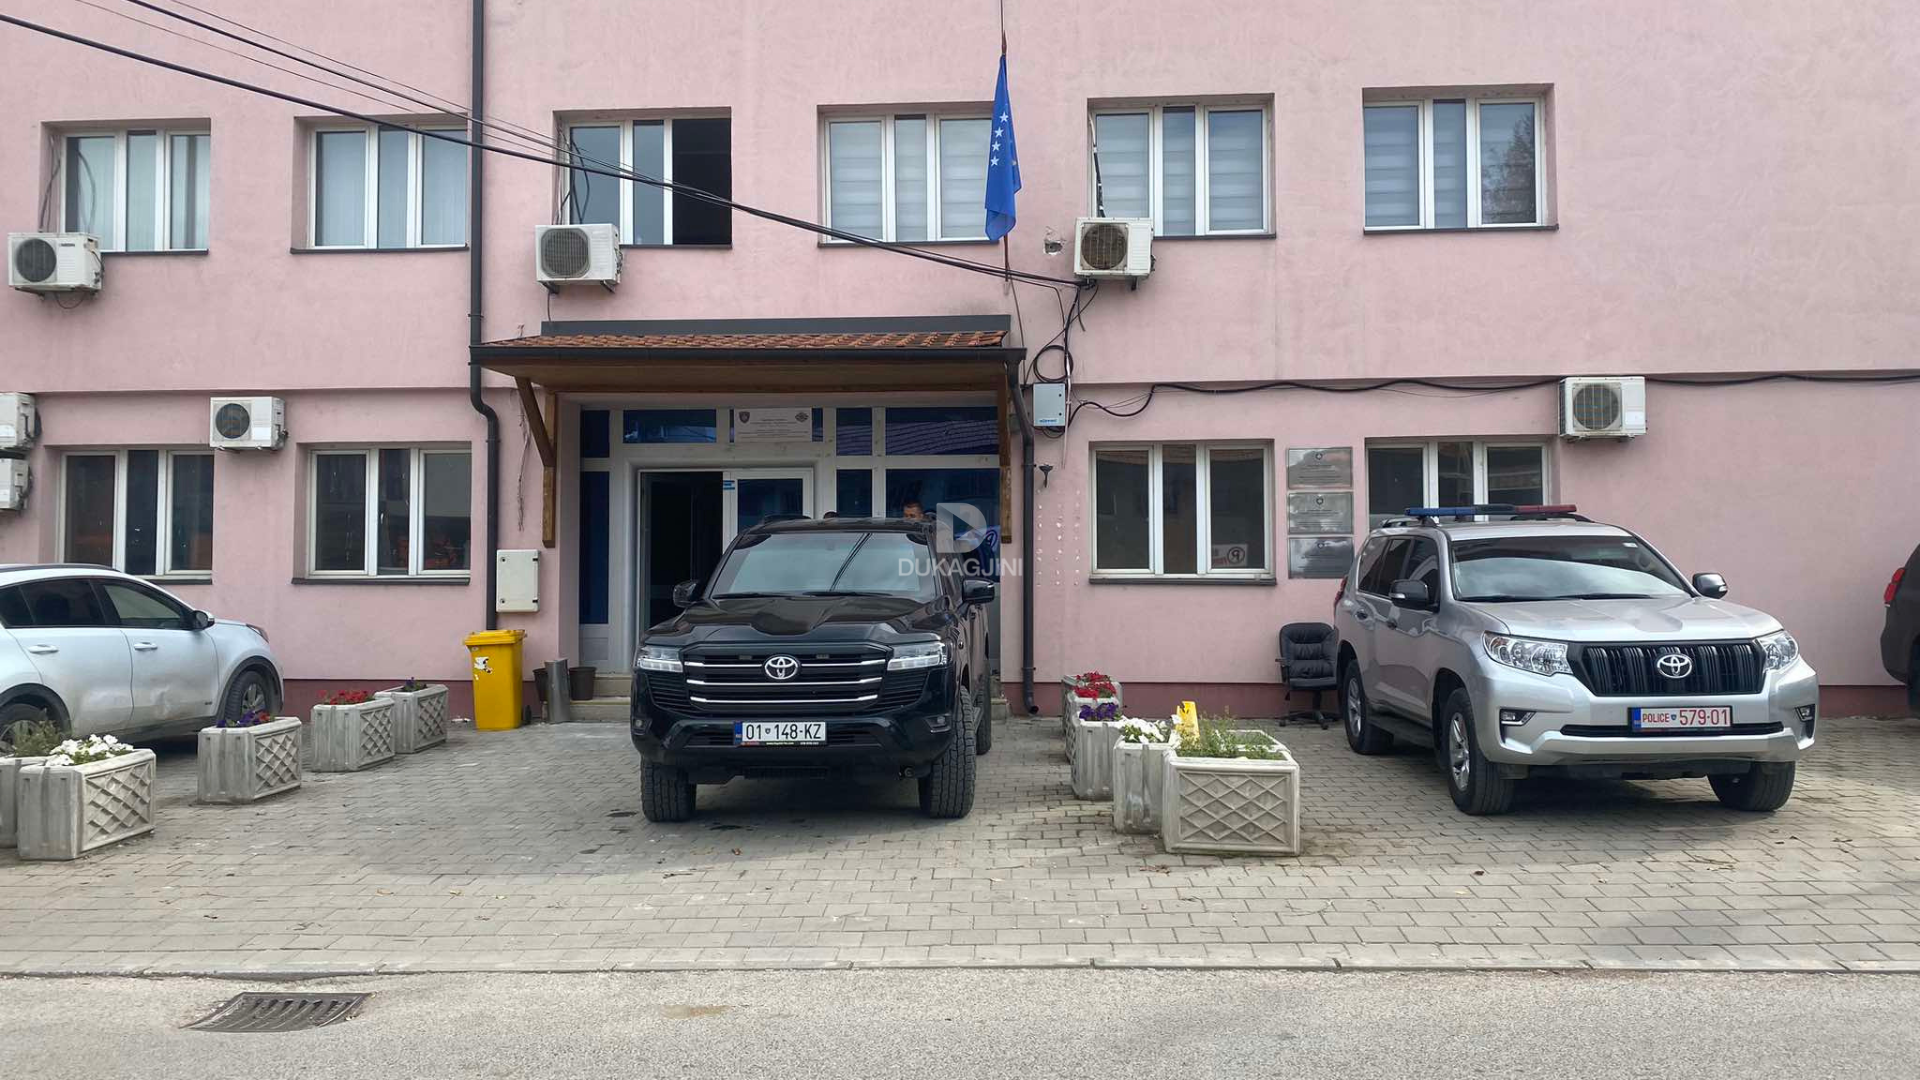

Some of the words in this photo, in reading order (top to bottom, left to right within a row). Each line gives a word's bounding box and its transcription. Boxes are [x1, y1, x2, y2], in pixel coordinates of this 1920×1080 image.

[1642, 713, 1670, 723] POLICE
[746, 723, 762, 740] 01
[774, 723, 822, 740] 148-KZ
